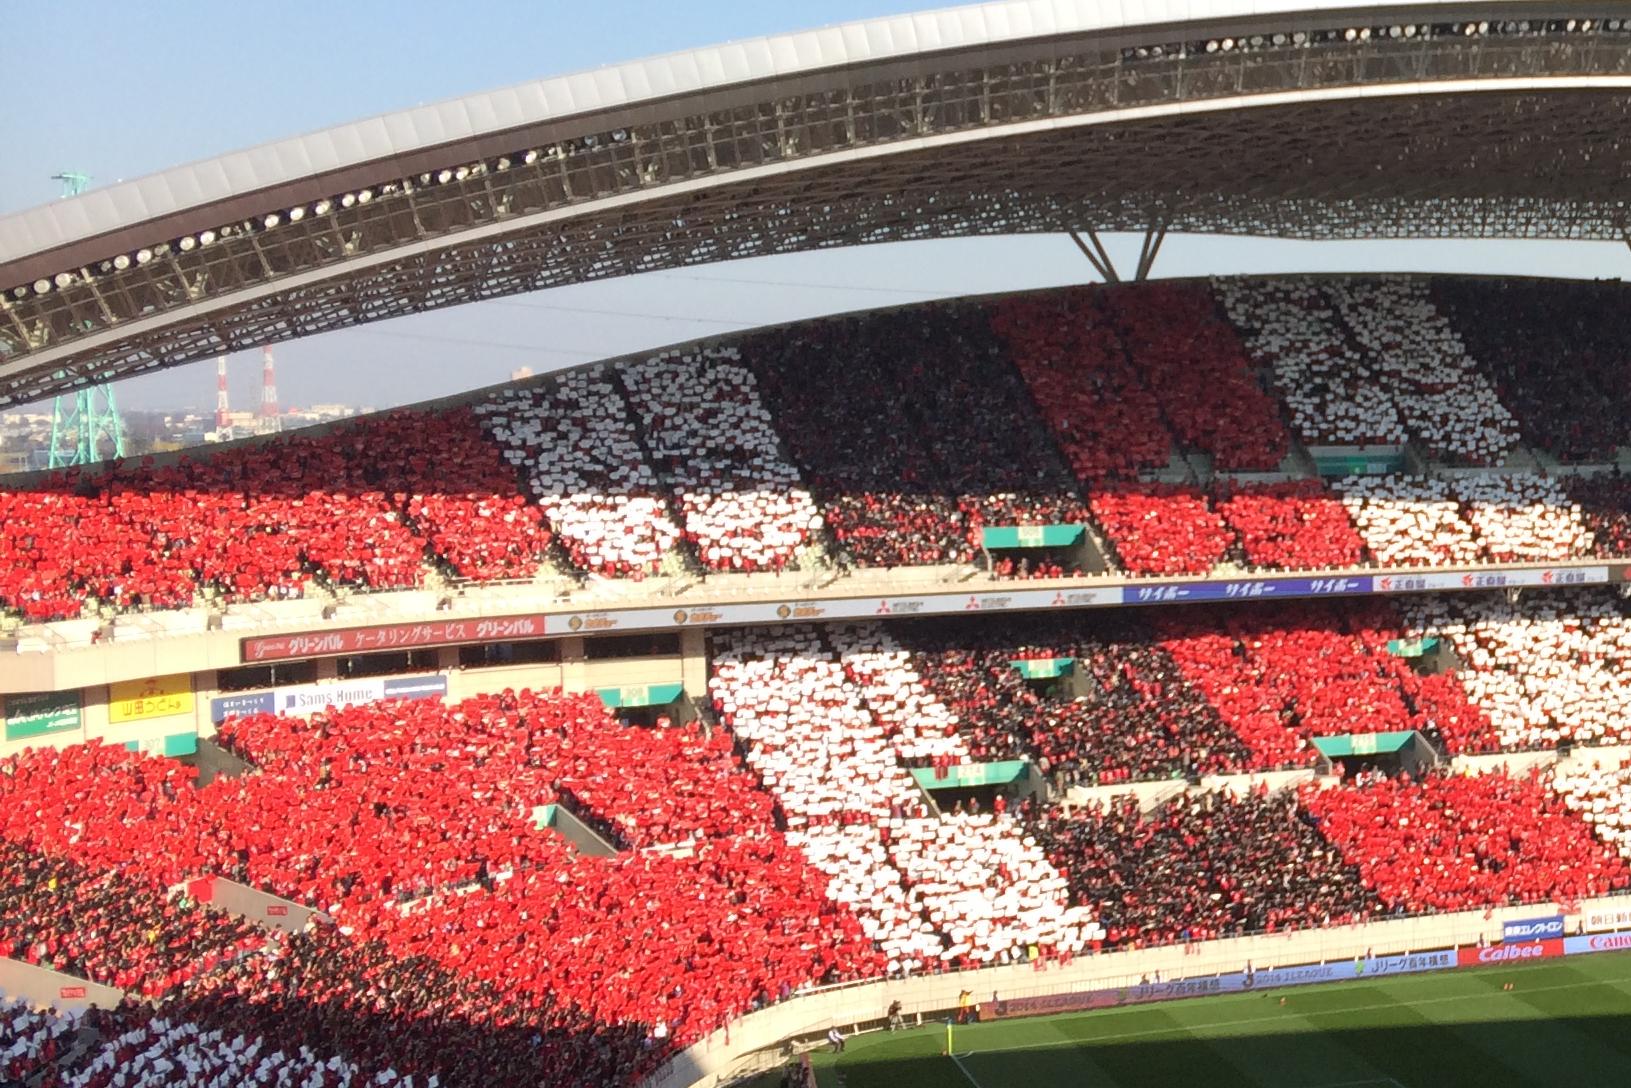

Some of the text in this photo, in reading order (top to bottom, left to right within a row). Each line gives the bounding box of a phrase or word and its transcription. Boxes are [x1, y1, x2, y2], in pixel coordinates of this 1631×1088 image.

[1138, 586, 1190, 600] サイボー
[1225, 582, 1276, 597] サイボー
[1311, 579, 1360, 593] サイボー
[355, 623, 466, 648] ケータリングサービス
[299, 691, 333, 707] Sams
[337, 688, 373, 702] Home
[122, 699, 177, 716] 山田うどん
[1505, 921, 1563, 937] 東京エレクトロン
[1478, 943, 1544, 962] Calbee
[1372, 954, 1449, 973] Jリーグ百年構想
[1137, 979, 1221, 999] Jリーグ百年構想
